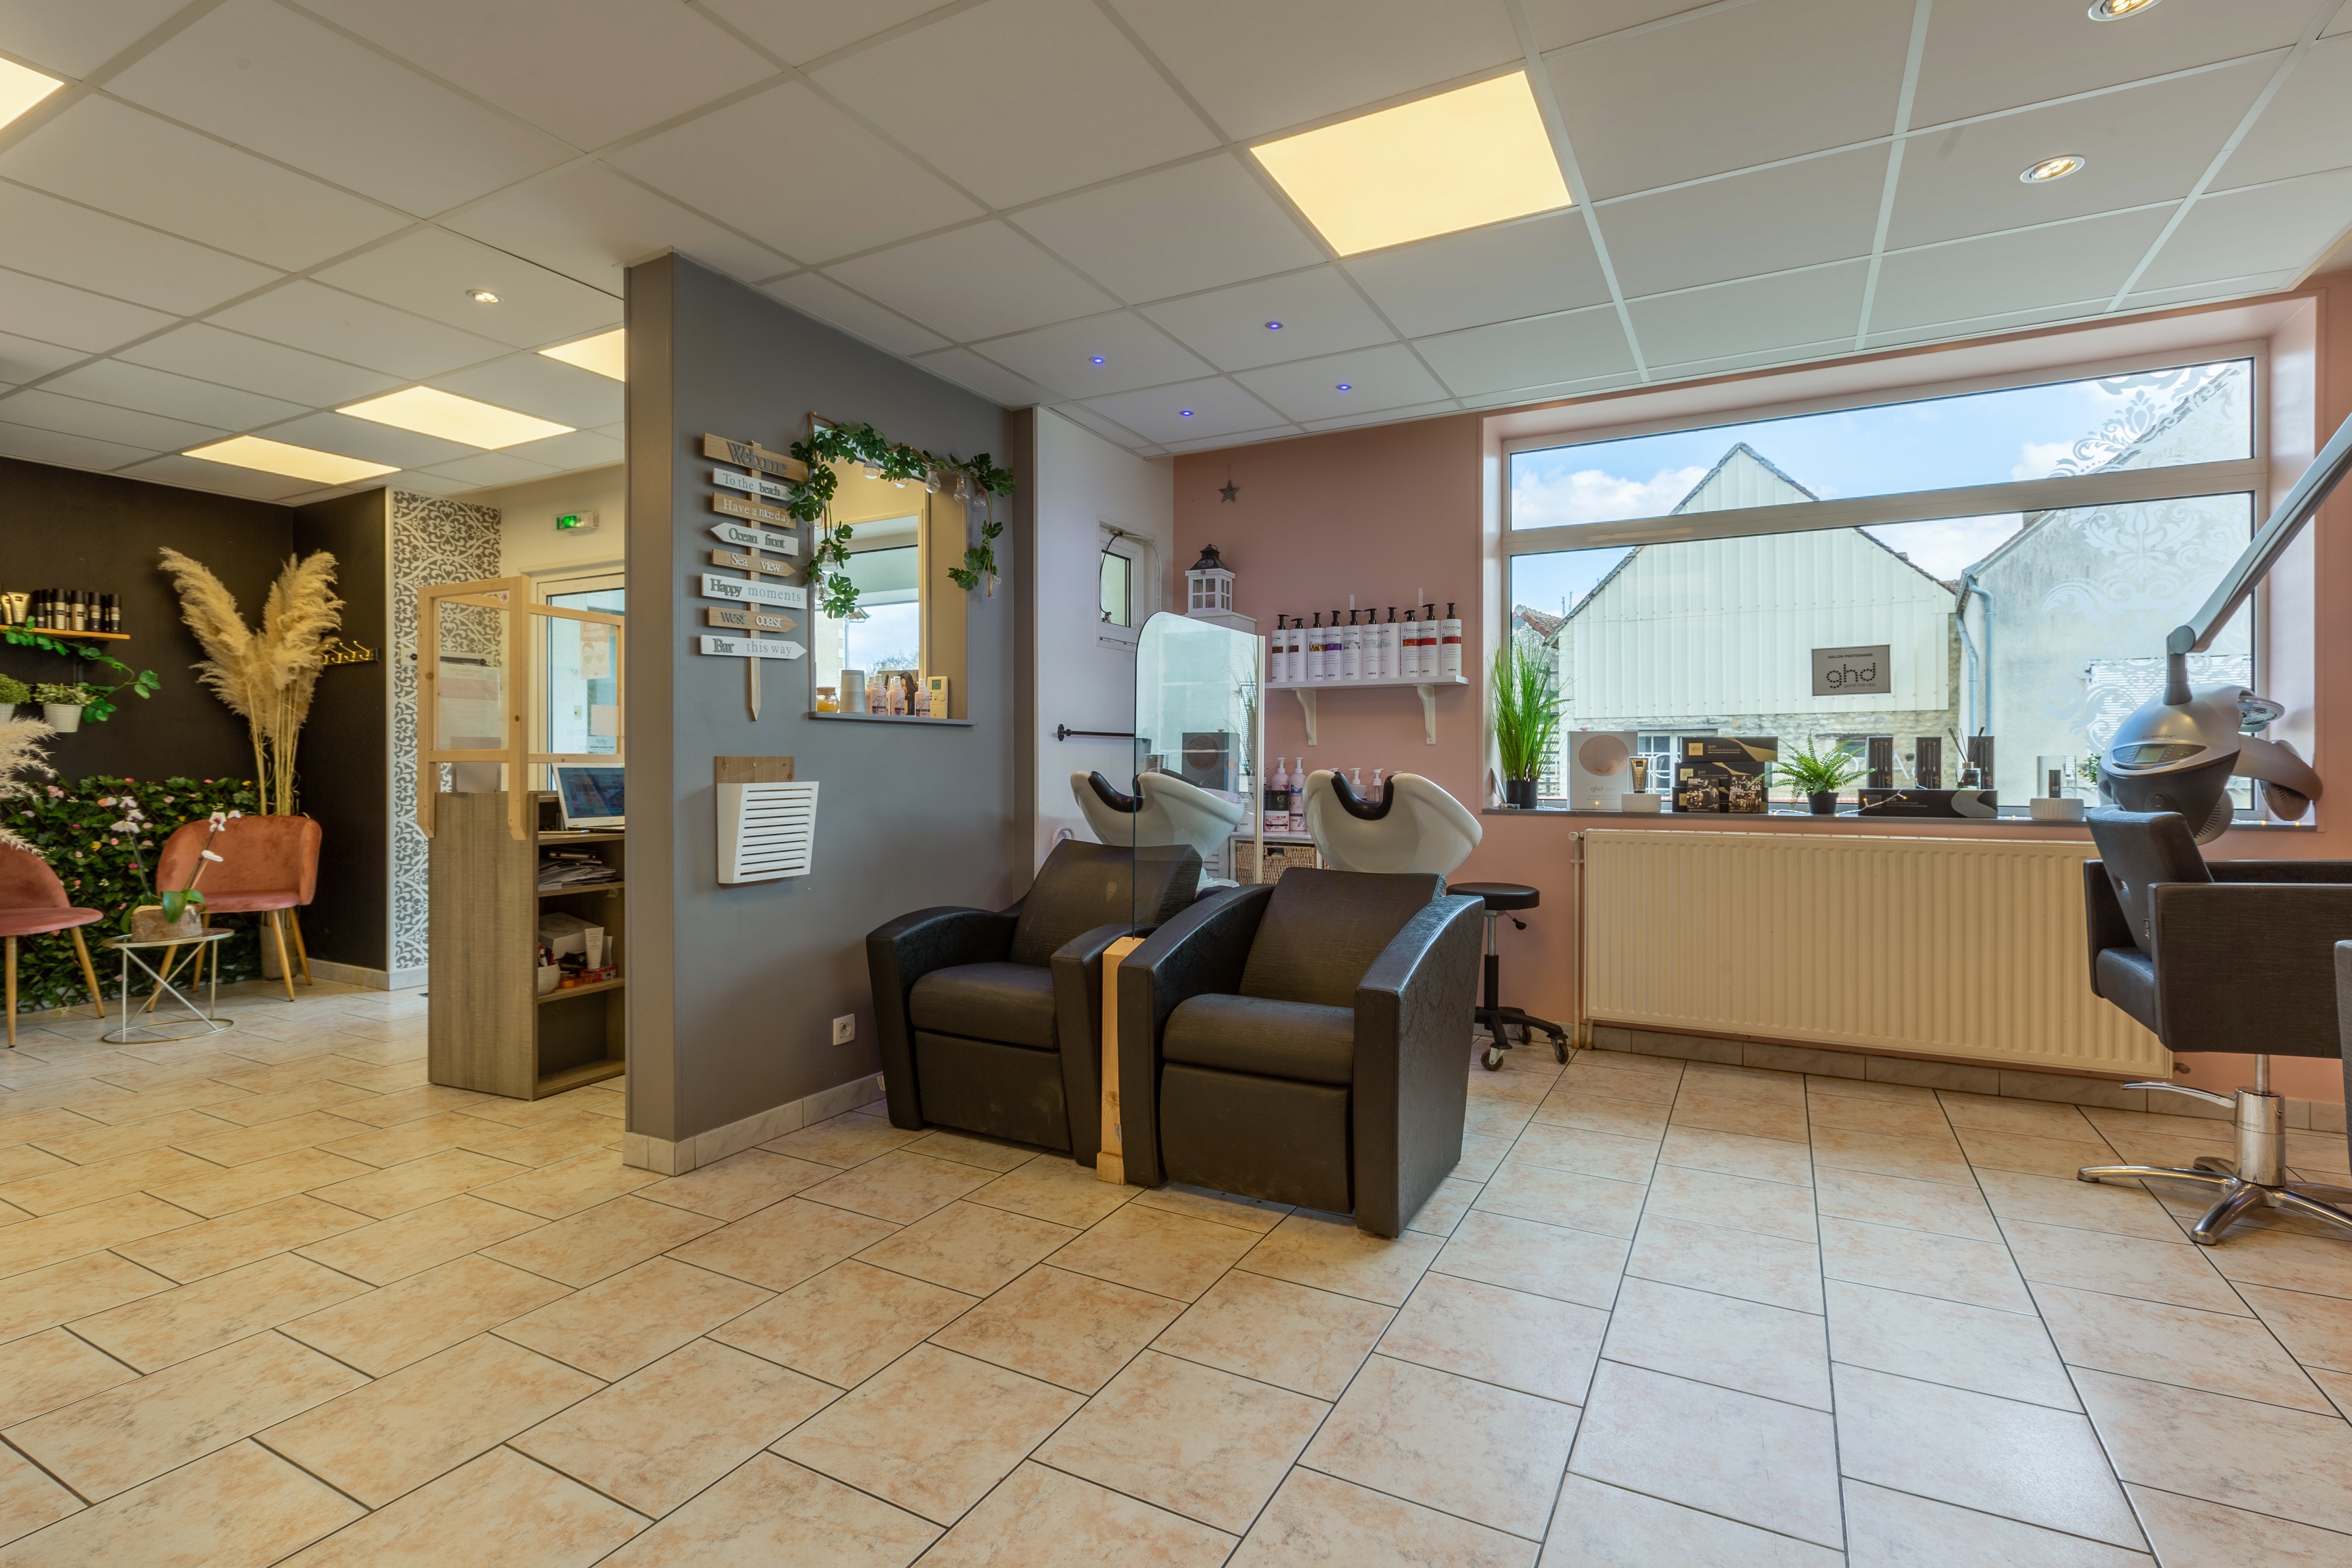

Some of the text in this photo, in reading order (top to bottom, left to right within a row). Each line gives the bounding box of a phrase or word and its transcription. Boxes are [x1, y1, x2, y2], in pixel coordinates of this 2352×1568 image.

[727, 441, 787, 476] Welcome
[723, 473, 780, 496] To the beach
[723, 498, 750, 514] Have
[759, 508, 774, 519] nice
[775, 511, 791, 525] day
[729, 528, 785, 548] Ocean front
[731, 553, 781, 573] Sea view
[710, 578, 801, 602] Happy moments
[721, 612, 782, 628] west coast
[713, 638, 792, 657] Bar this way
[1826, 662, 1876, 689] ghd
